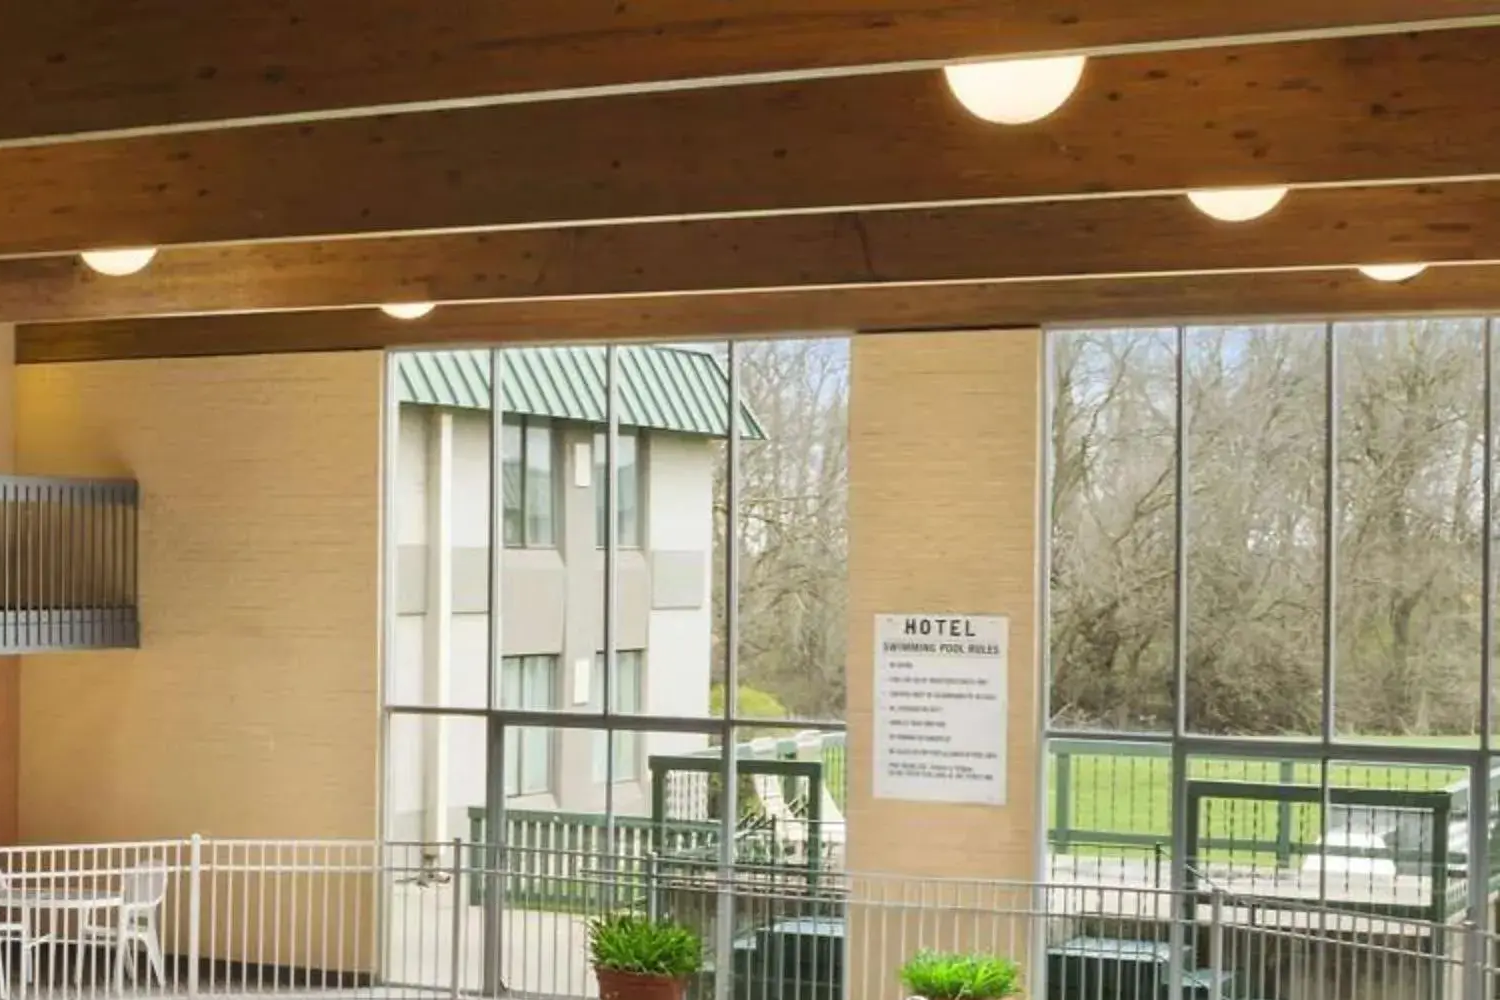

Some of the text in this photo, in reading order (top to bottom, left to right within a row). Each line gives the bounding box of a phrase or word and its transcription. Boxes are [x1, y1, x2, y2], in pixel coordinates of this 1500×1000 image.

[904, 618, 976, 637] HOTEL
[883, 641, 1000, 655] SWIMMING POOL RULES
